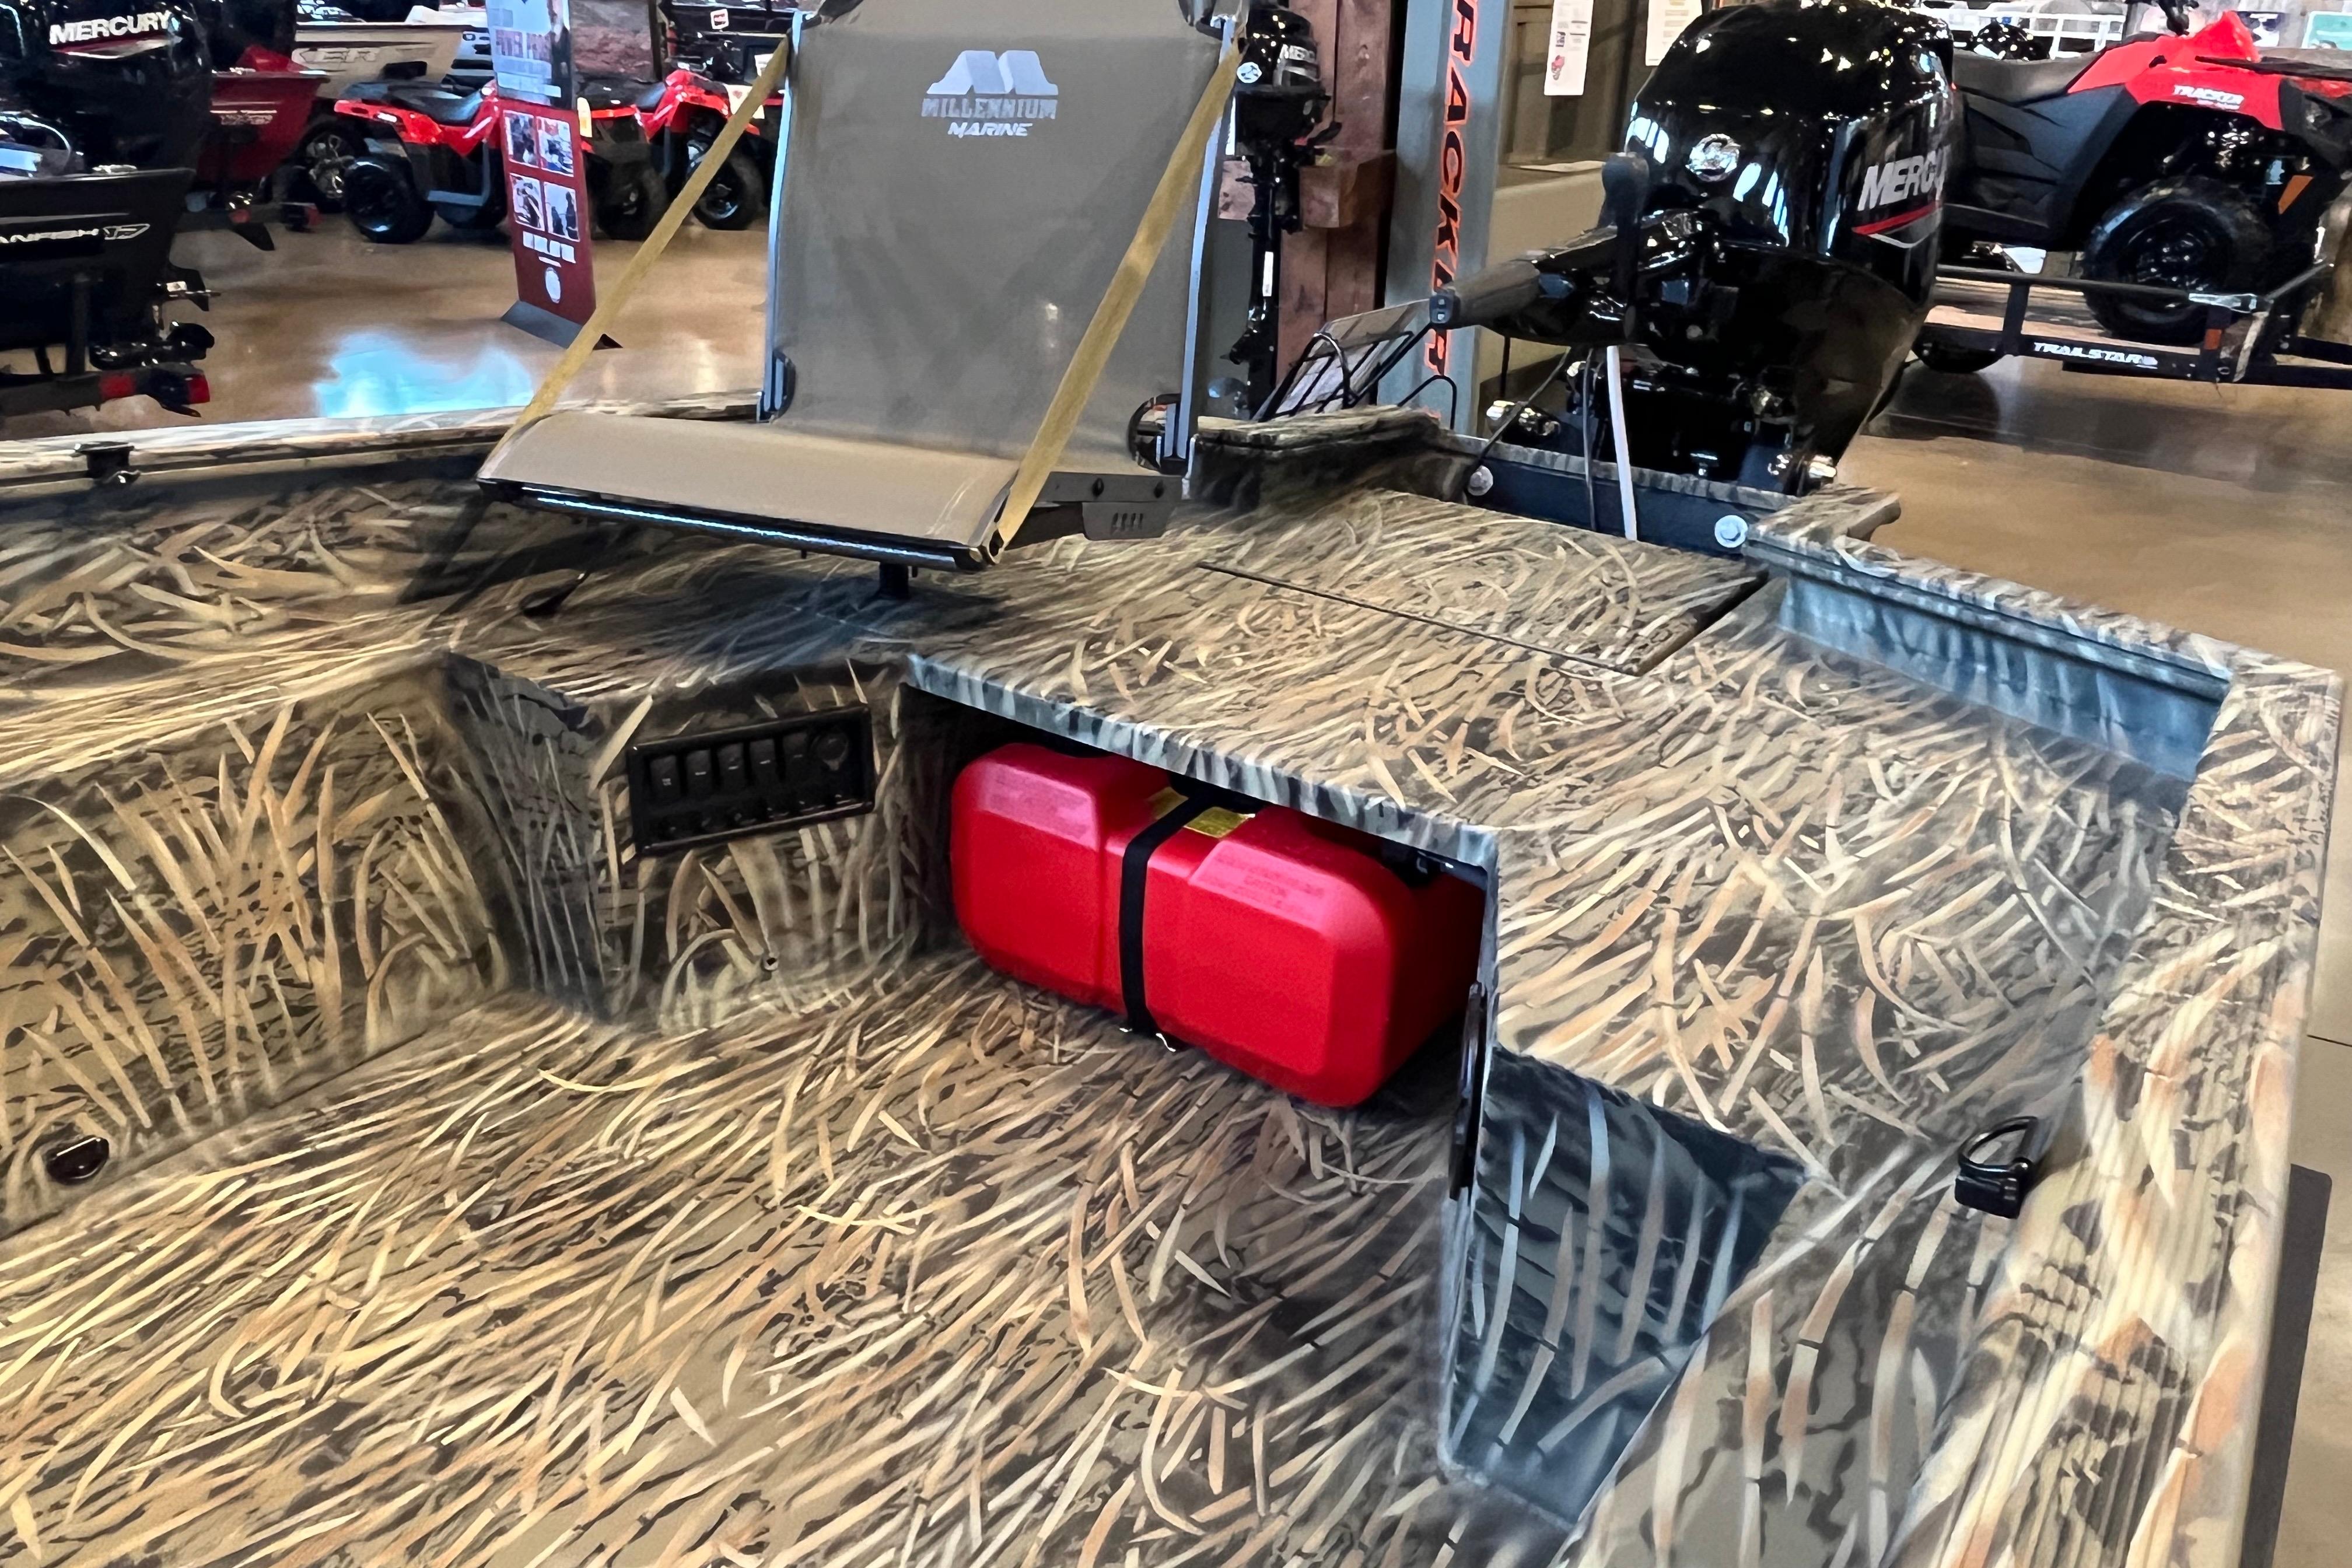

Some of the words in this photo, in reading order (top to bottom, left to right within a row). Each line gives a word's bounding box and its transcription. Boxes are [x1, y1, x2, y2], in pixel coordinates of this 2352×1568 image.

[49, 10, 173, 45] MERCURY
[921, 98, 1058, 119] MILLENNIUM
[947, 121, 1033, 138] MARINE
[1424, 0, 1478, 377] RACKR
[1857, 145, 1951, 211] MERCU
